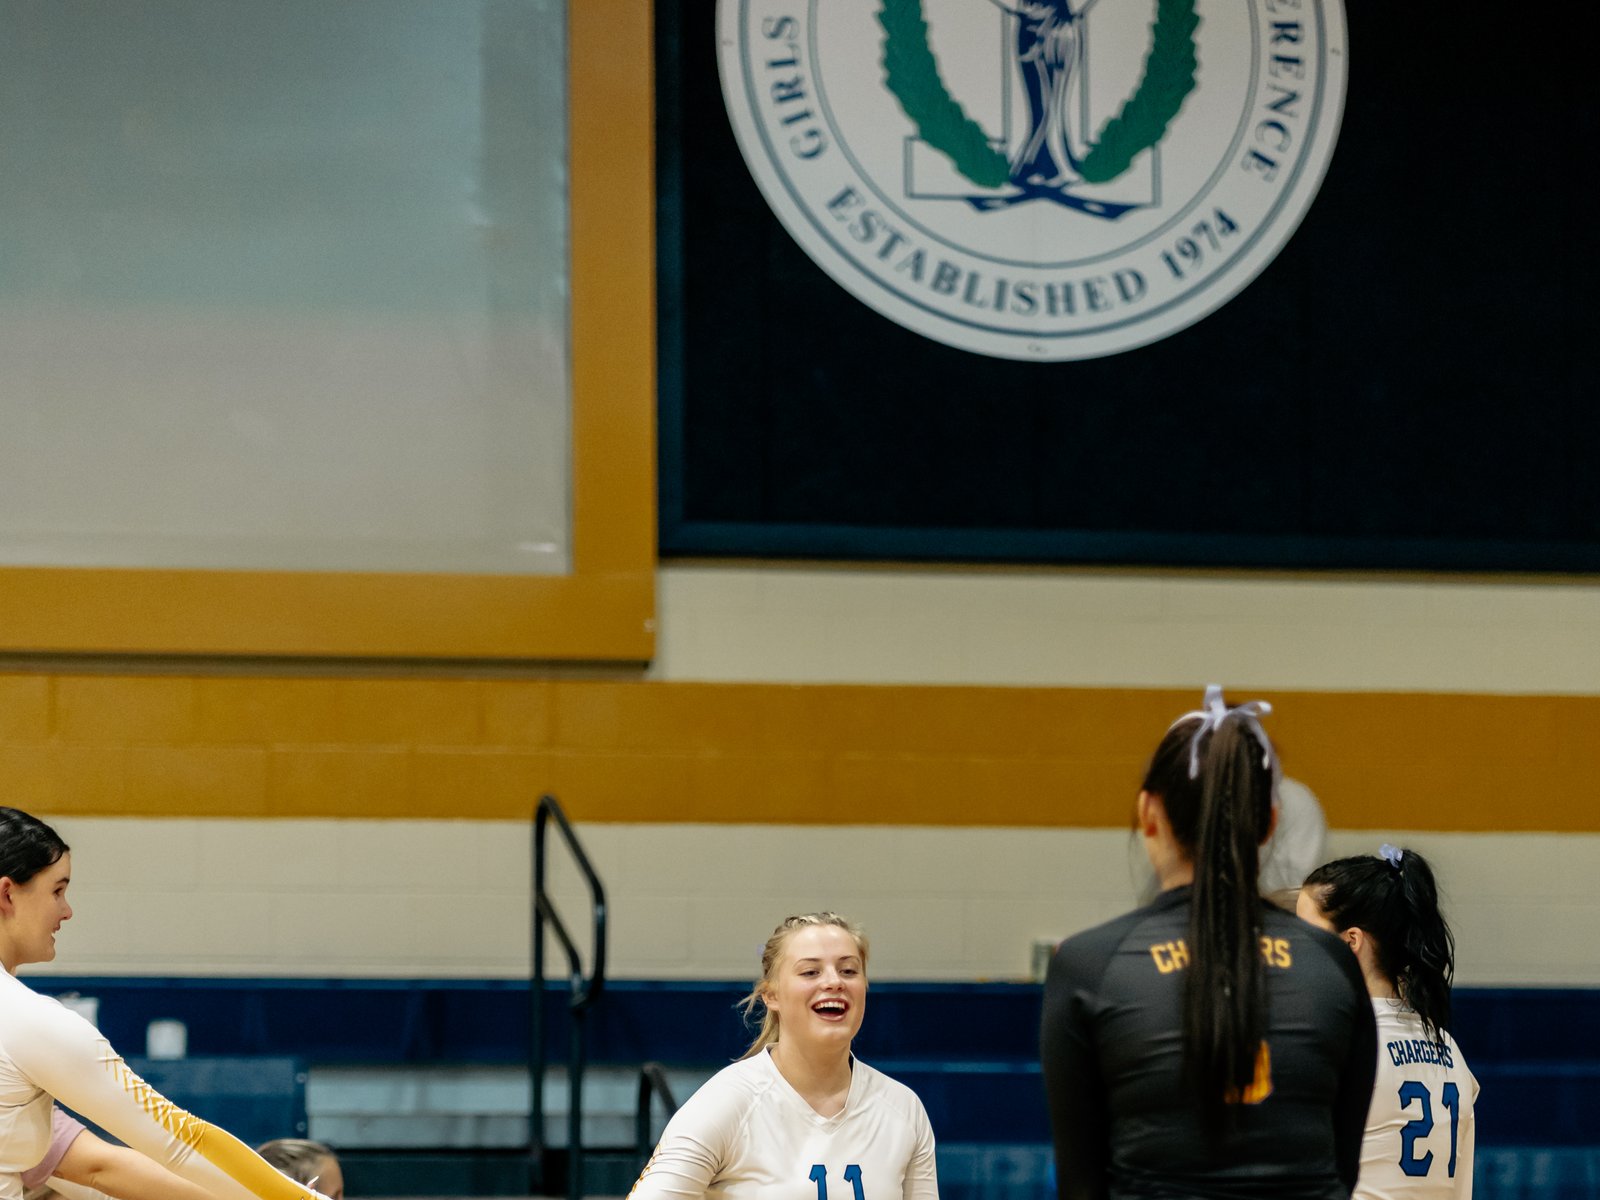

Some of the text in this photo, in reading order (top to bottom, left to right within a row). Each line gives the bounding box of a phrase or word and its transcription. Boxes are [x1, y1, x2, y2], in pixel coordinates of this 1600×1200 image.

[761, 15, 828, 161] GIRLS
[826, 187, 1240, 317] ESTABLISHED 1974
[1150, 936, 1292, 974] CHRS
[1386, 1039, 1454, 1069] CHARGERS
[1398, 1080, 1460, 1178] 21
